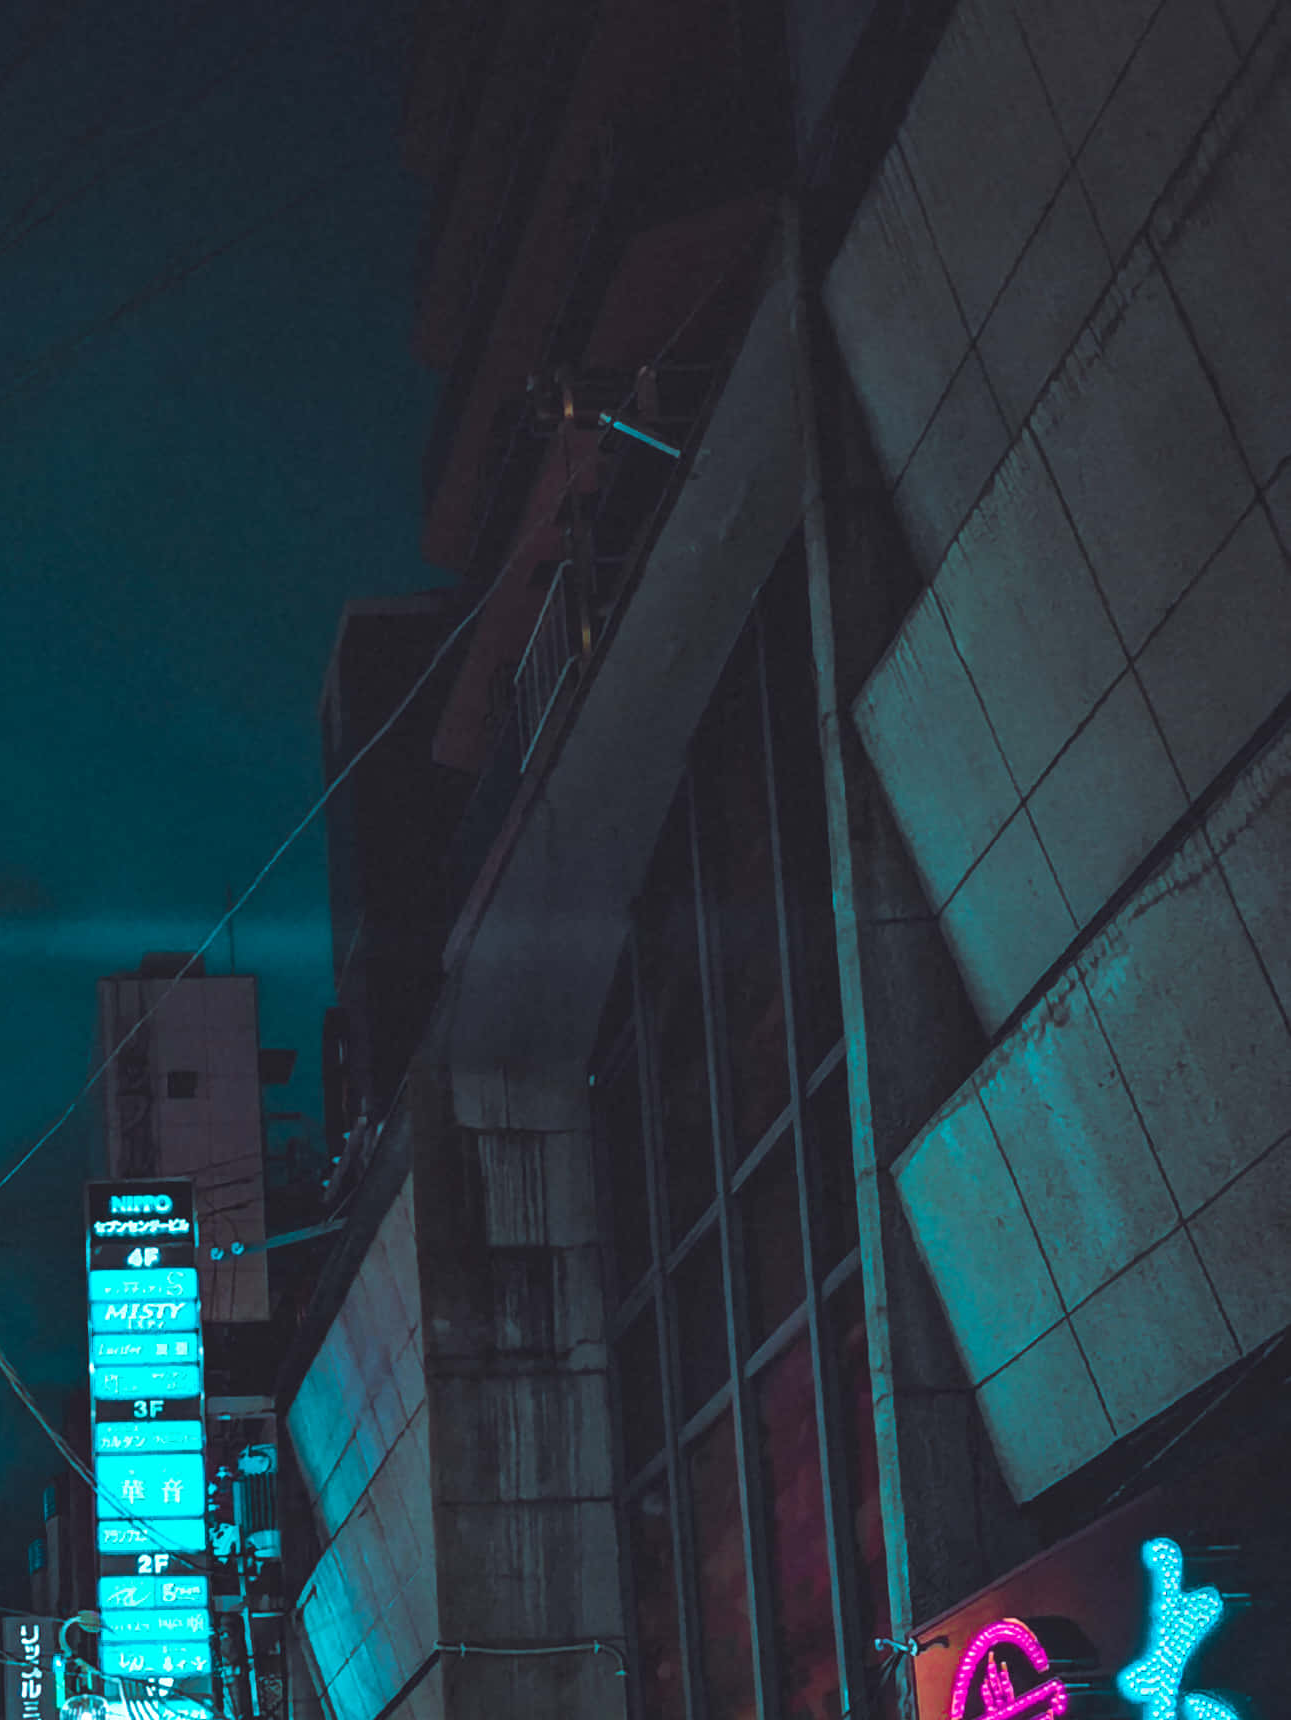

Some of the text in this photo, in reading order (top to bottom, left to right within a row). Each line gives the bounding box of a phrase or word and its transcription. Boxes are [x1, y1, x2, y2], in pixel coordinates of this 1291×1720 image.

[127, 1247, 160, 1267] 4F
[105, 1302, 186, 1320] MISTY
[133, 1399, 165, 1418] 3F
[137, 1554, 170, 1575] 2F
